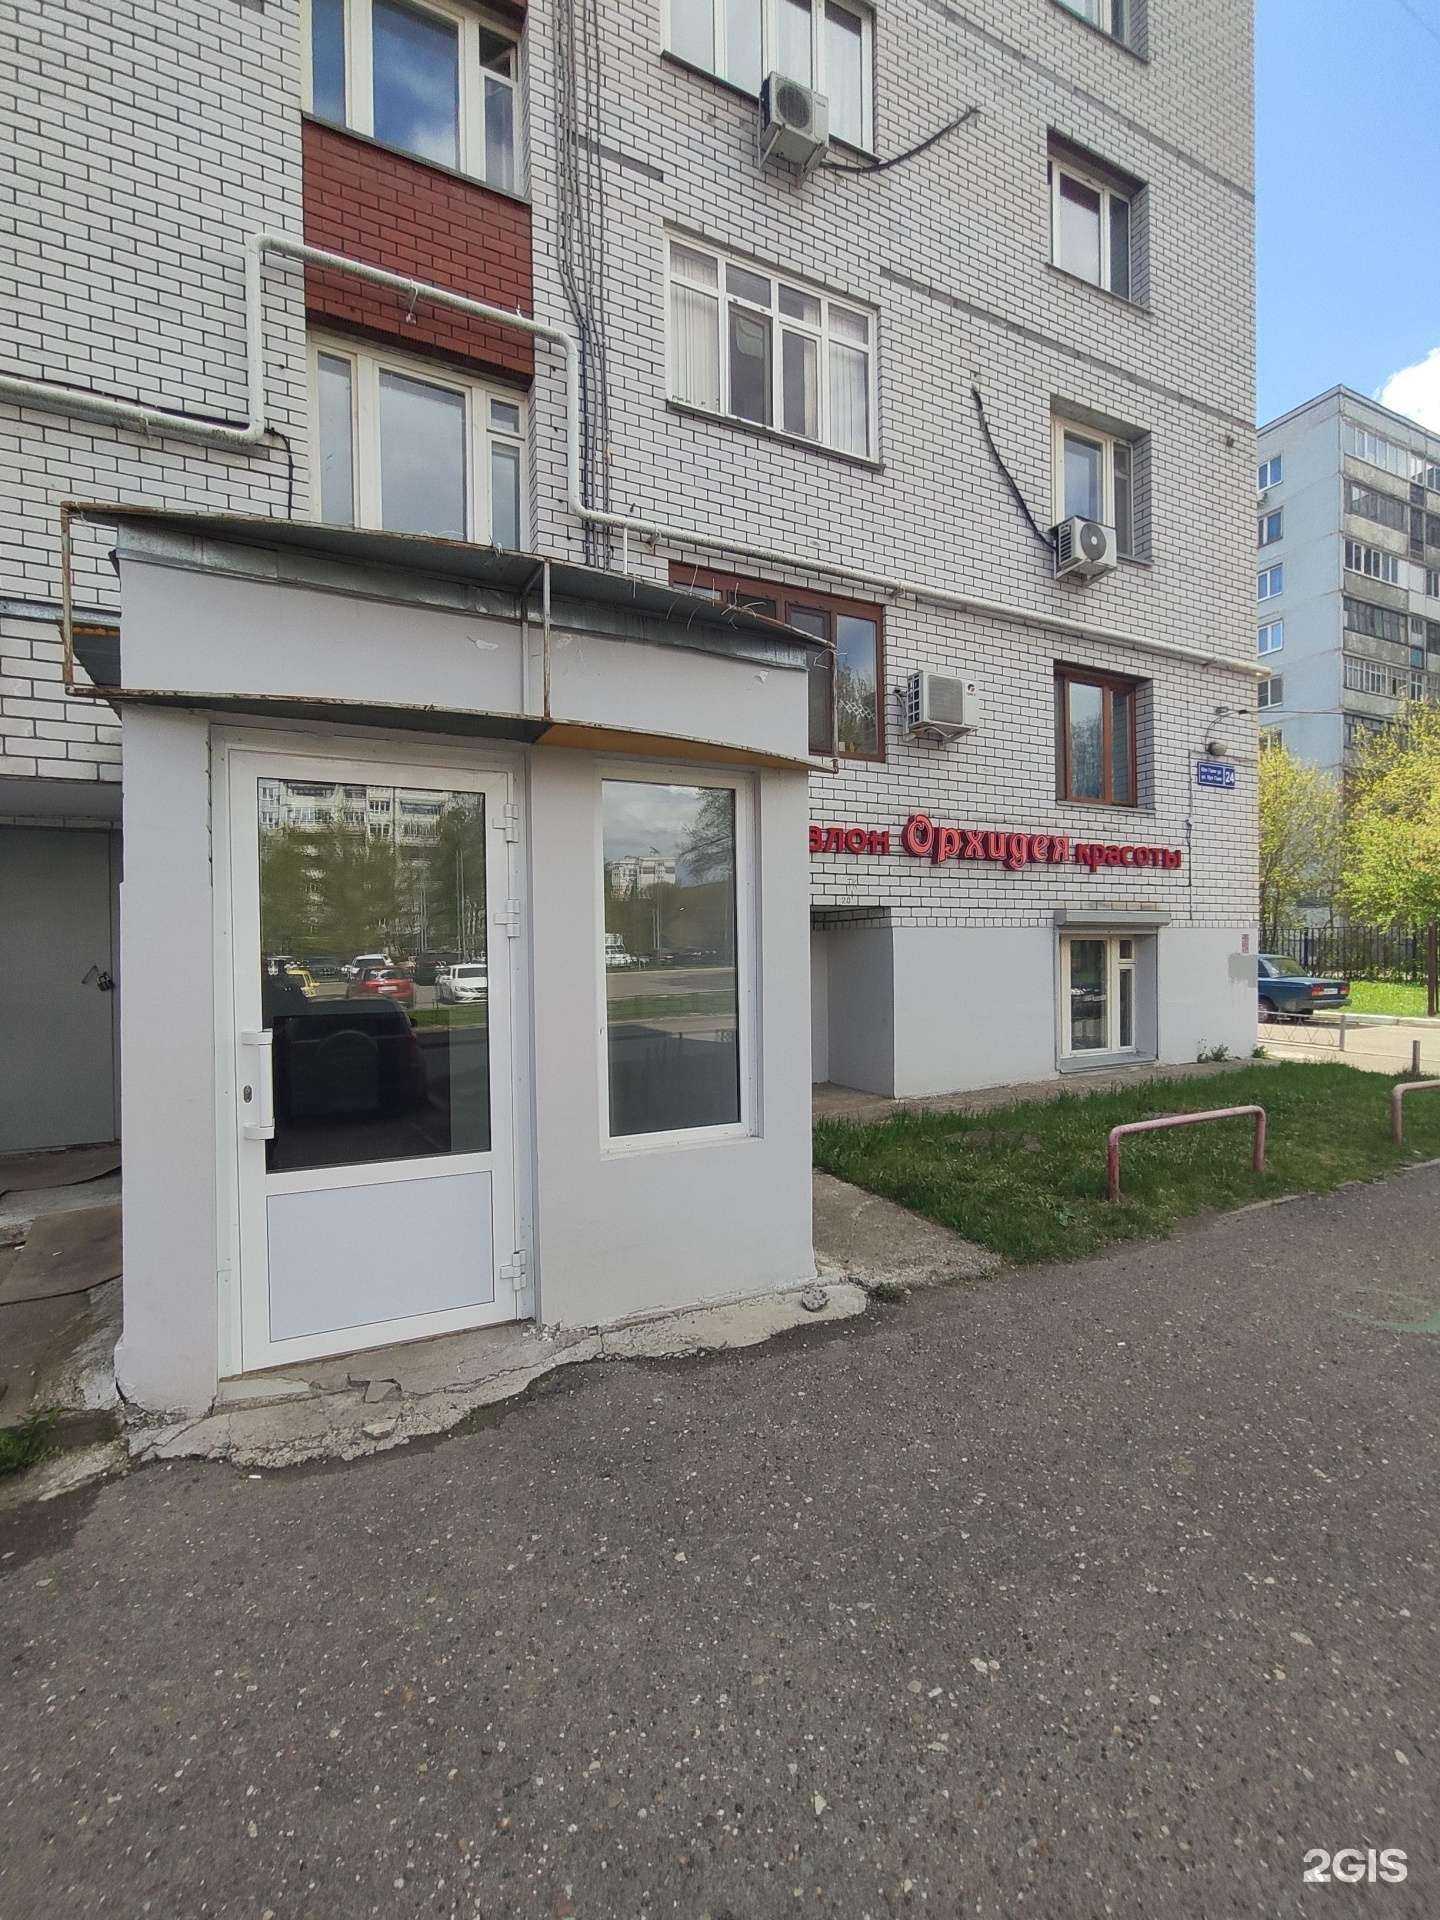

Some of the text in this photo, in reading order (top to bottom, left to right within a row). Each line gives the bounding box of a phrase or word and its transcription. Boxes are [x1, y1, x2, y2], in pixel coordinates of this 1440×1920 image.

[1225, 771, 1234, 784] 24
[809, 814, 1182, 872] алон Орхидея красоты
